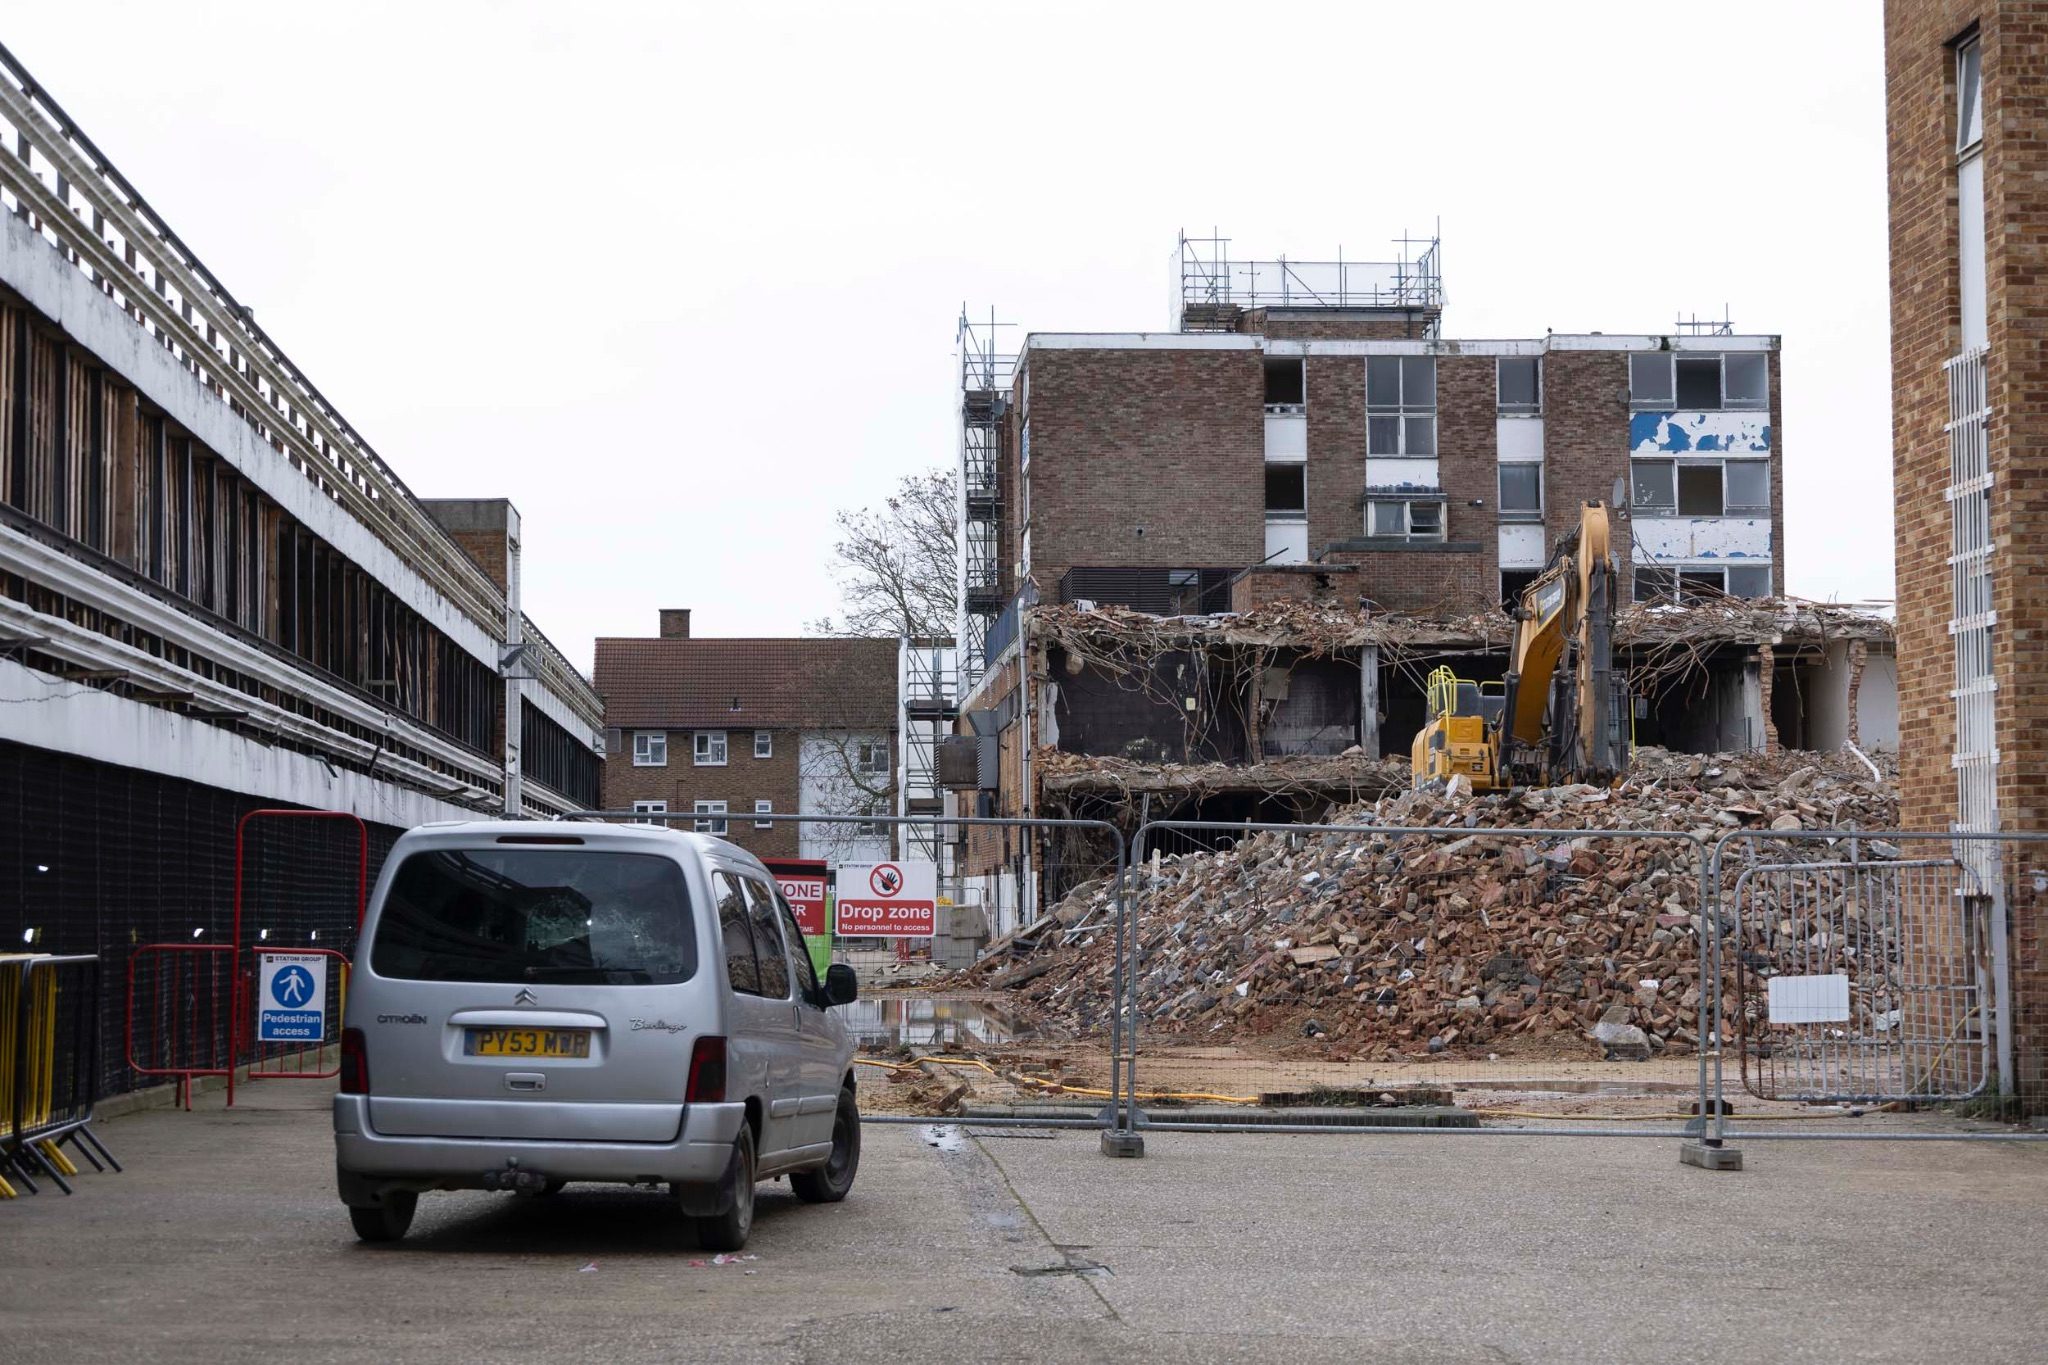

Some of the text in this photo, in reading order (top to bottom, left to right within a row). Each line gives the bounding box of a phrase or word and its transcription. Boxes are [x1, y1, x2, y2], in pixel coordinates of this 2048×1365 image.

[778, 883, 821, 898] ONE
[841, 903, 931, 922] Drop zone
[854, 923, 892, 931] personnel
[263, 1013, 321, 1023] Pedestrian
[272, 1027, 310, 1036] access
[479, 1031, 538, 1053] PY53
